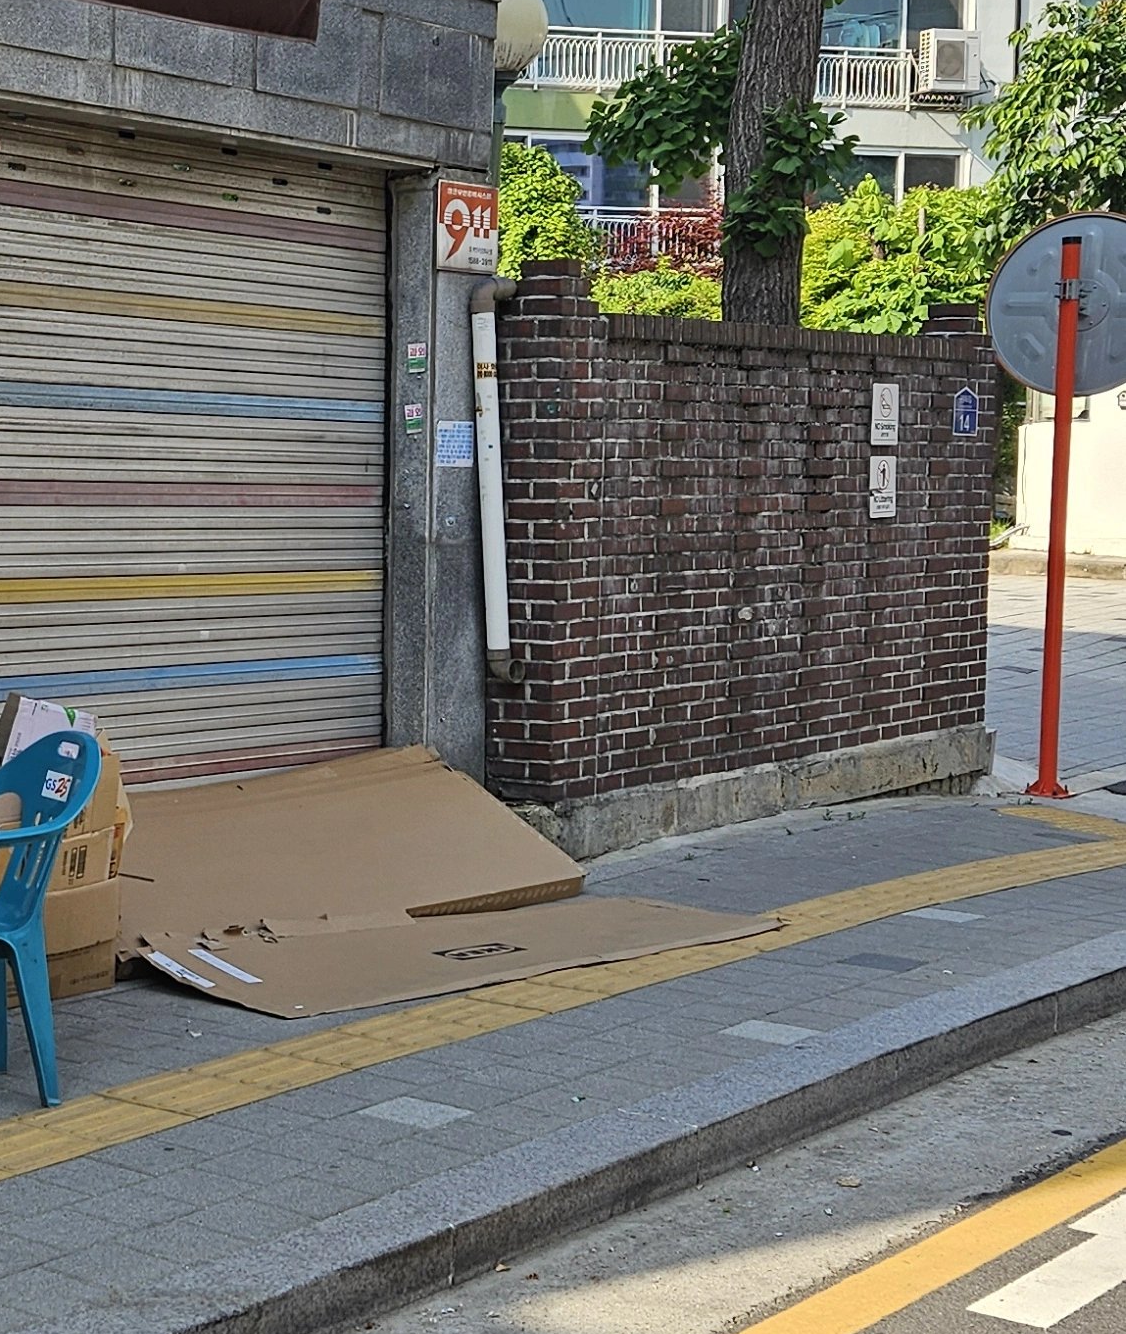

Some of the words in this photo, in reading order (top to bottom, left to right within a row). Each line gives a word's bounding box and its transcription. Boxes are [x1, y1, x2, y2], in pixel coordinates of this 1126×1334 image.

[444, 198, 491, 262] 911
[959, 414, 970, 432] 14
[45, 777, 71, 797] GS25
